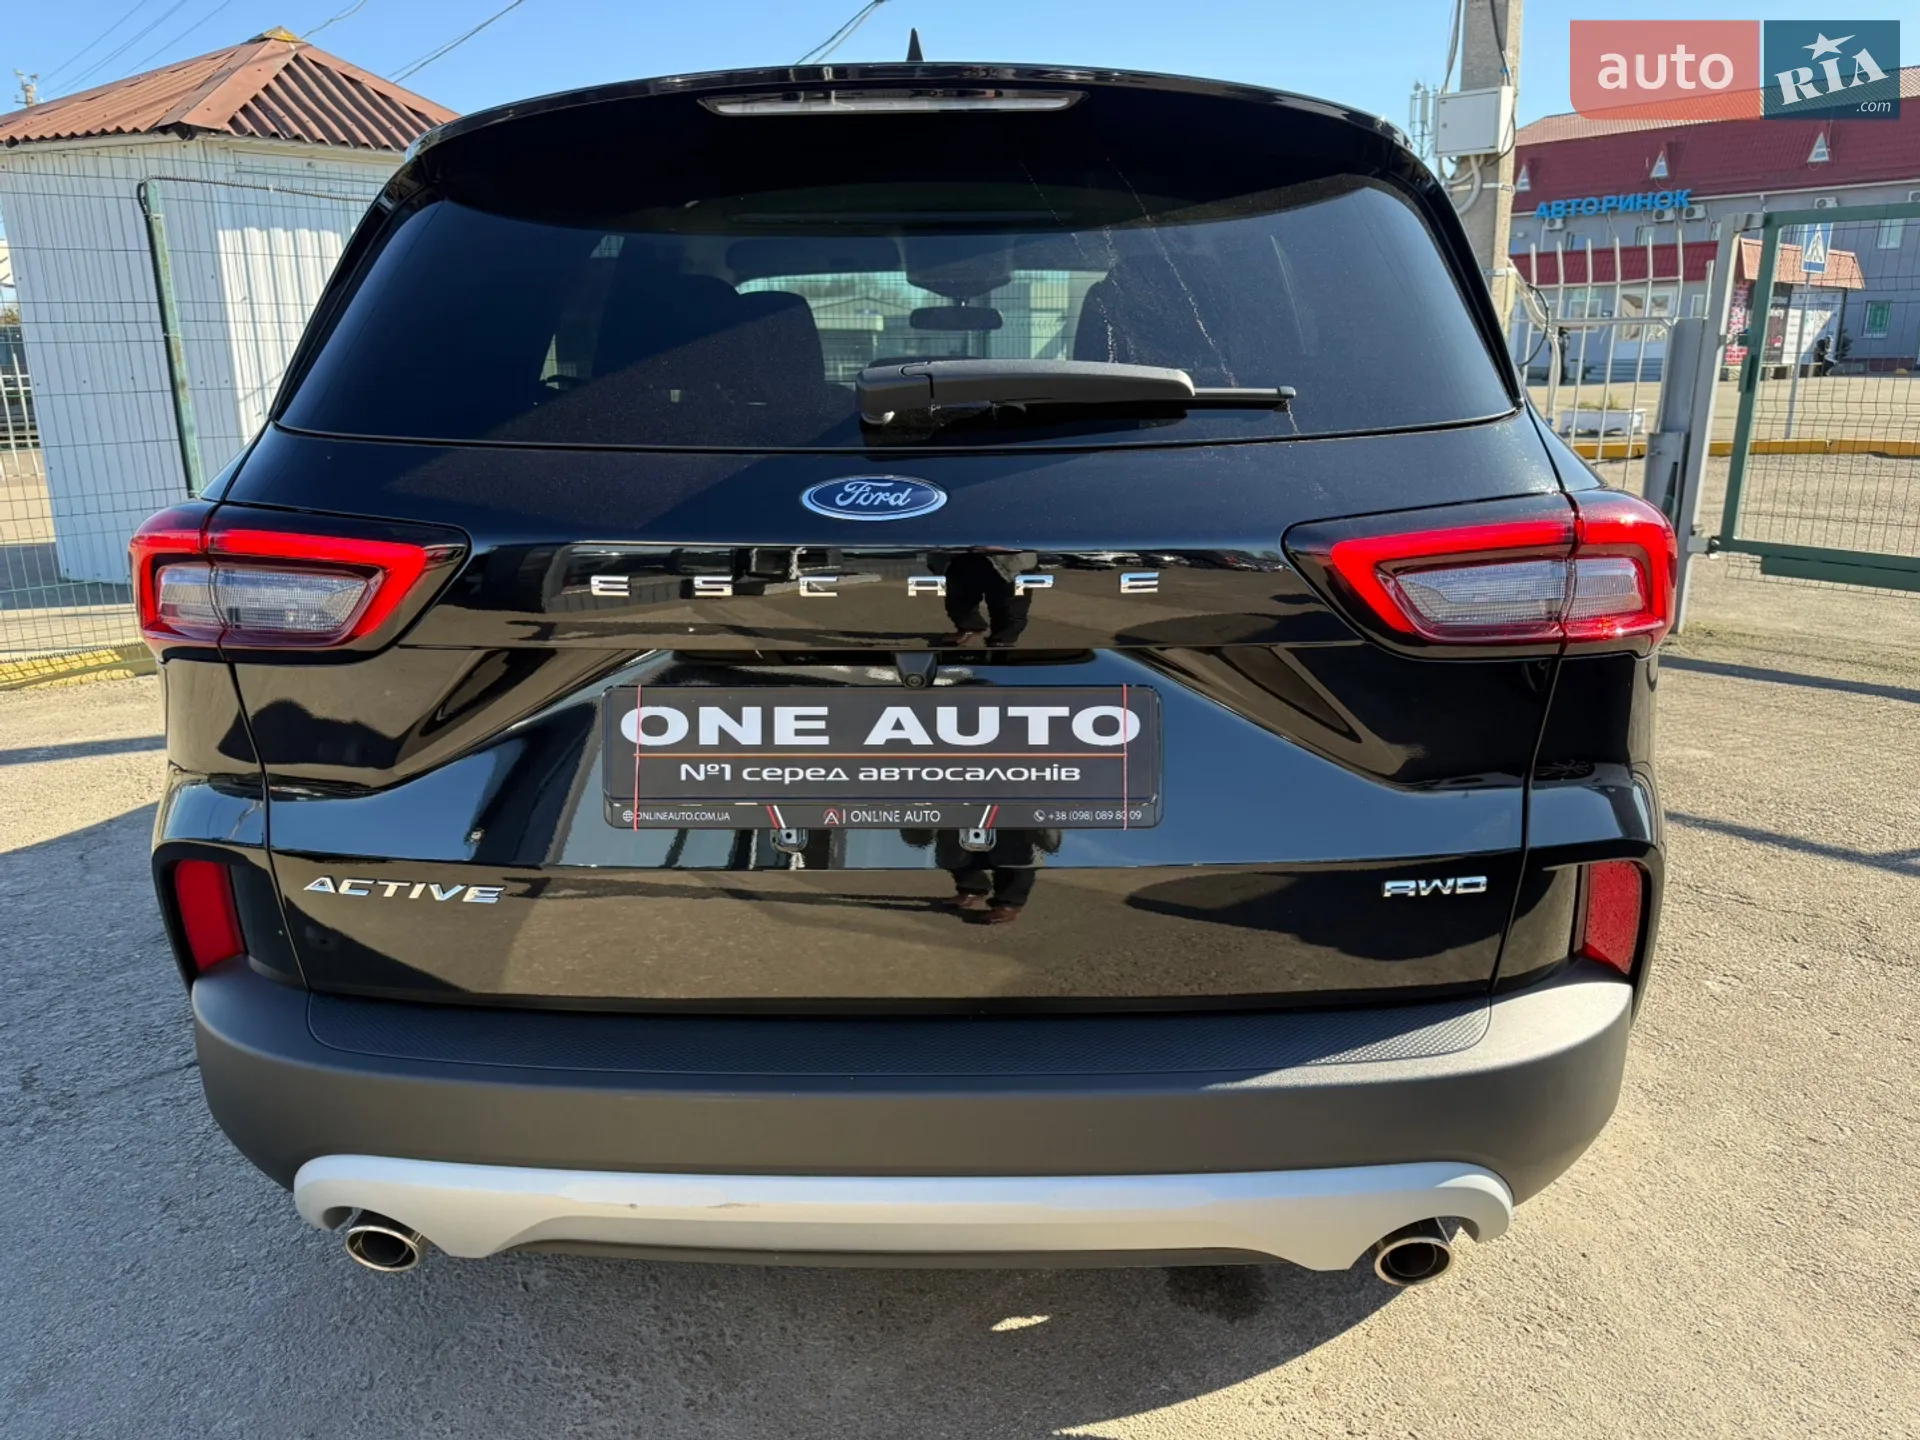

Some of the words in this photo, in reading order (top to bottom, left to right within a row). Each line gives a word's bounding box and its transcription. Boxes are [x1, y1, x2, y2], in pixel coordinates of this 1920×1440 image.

[1534, 188, 1692, 220] АВТОРИНОК
[834, 481, 912, 507] Ford
[590, 572, 1159, 597] ESCAPE
[620, 705, 830, 746] ONE
[863, 705, 1141, 746] AUTO
[679, 763, 731, 781] №1
[742, 767, 849, 785] серед
[858, 763, 1081, 781] автосалонів
[850, 810, 900, 822] ONLINE
[904, 810, 941, 822] AUTO
[1048, 811, 1067, 820] +38
[1069, 811, 1093, 821] (098)
[1095, 811, 1114, 820] 089
[1129, 811, 1142, 820] 09
[303, 877, 506, 904] ACTIVE
[1383, 876, 1487, 897] AWD
